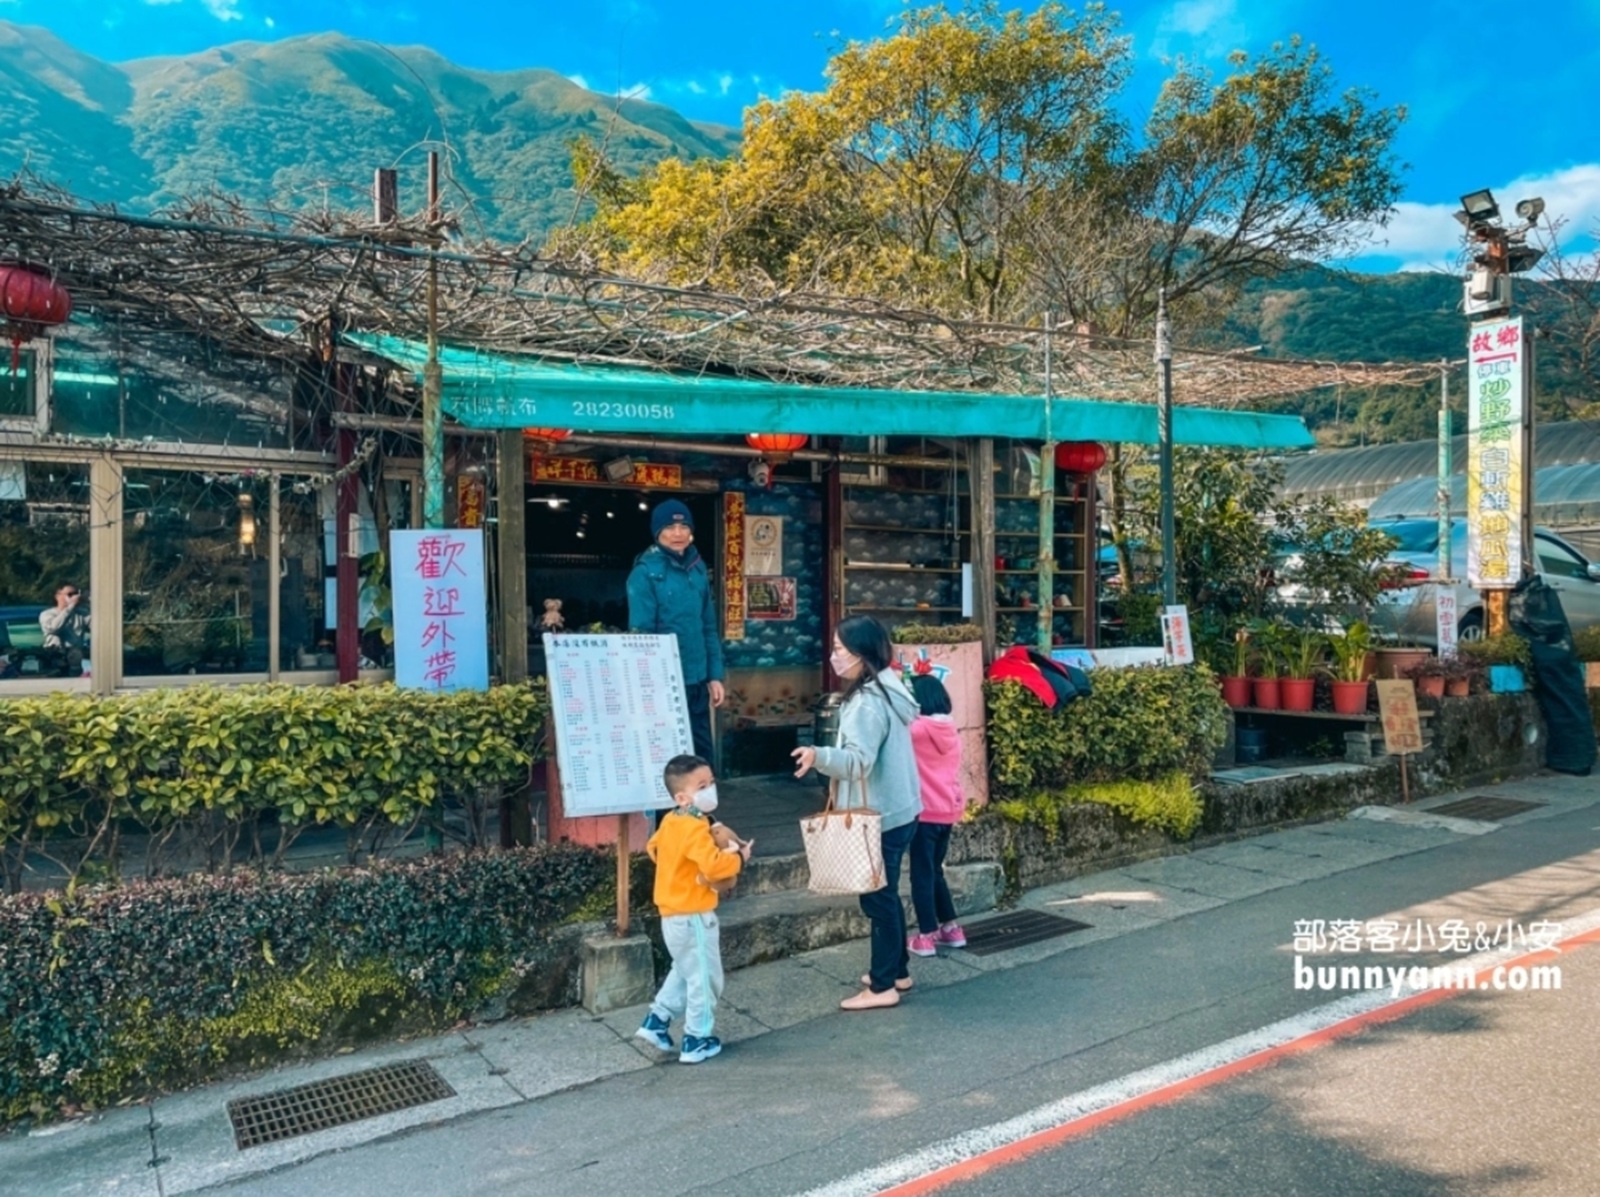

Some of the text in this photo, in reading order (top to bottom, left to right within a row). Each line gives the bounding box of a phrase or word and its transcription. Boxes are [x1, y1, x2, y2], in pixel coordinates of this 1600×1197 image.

[1472, 325, 1520, 353] 故鄉
[1477, 360, 1511, 379] 停車
[572, 401, 675, 420] 28230058
[1479, 379, 1511, 443] 炒野菜
[1480, 447, 1510, 511] 白斬雞
[415, 538, 468, 689] 歡迎外帶
